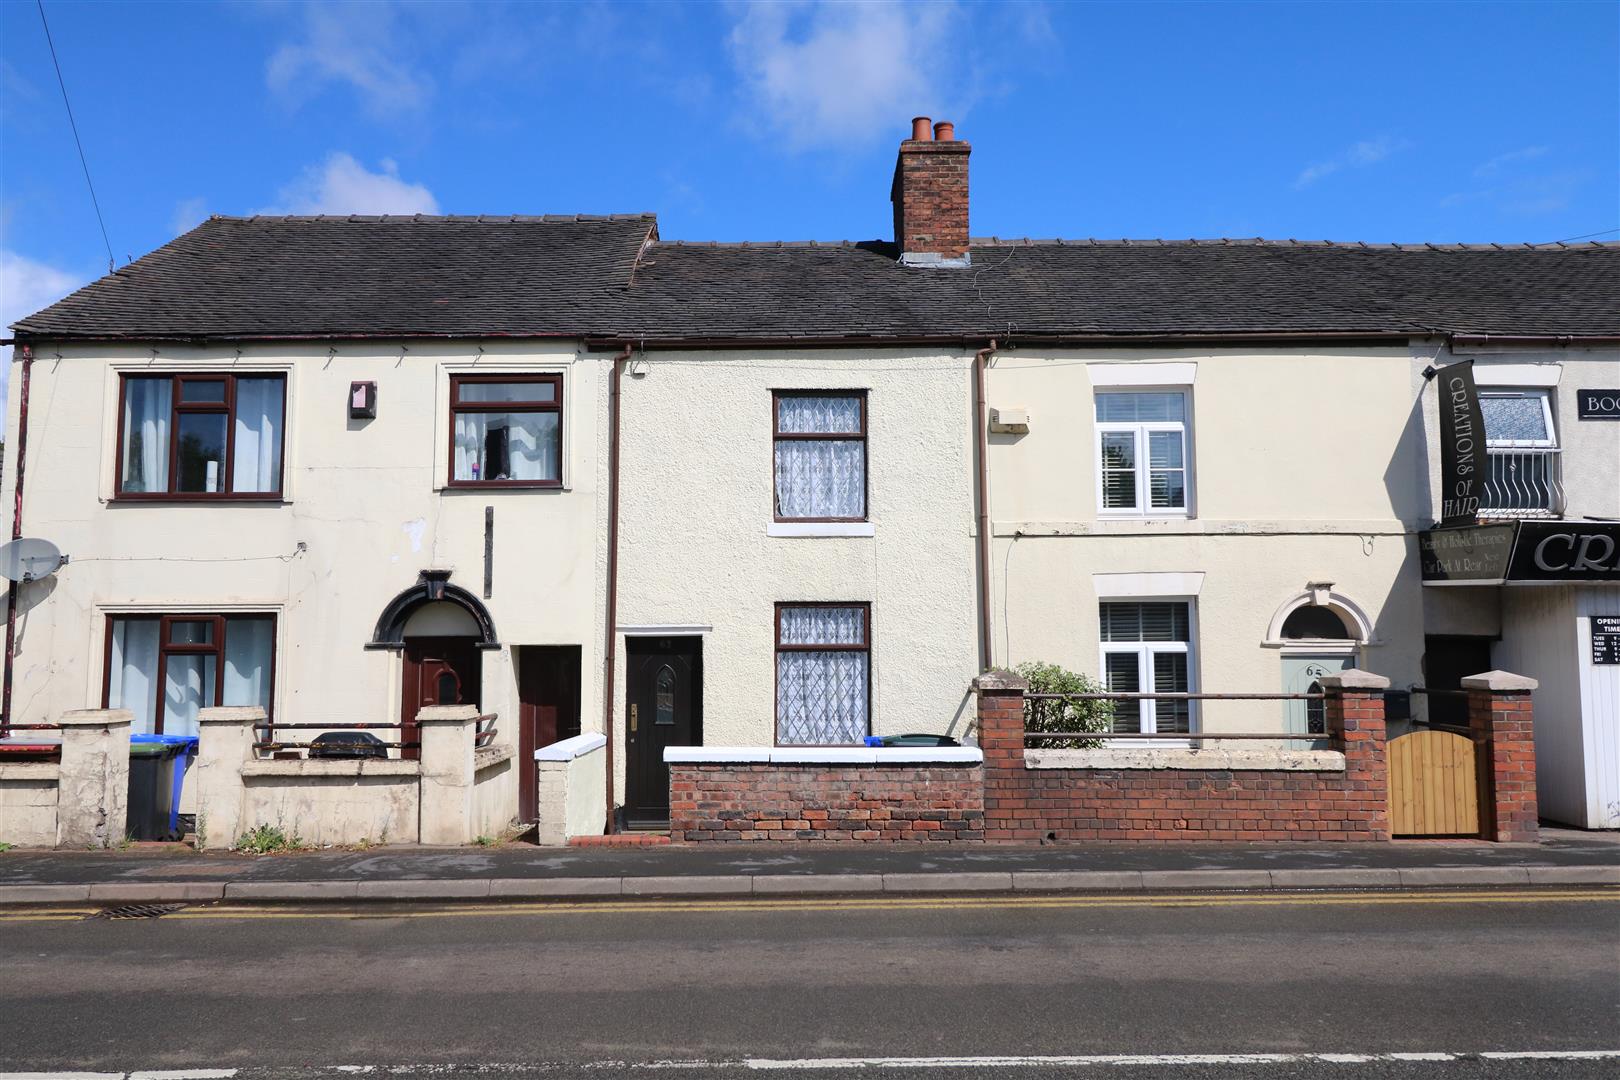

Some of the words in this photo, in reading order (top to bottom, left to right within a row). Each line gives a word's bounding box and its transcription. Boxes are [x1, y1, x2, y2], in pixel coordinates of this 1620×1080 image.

[1587, 396, 1620, 411] BO
[1449, 377, 1474, 475] CREATIONS
[1455, 479, 1473, 497] OF
[1443, 496, 1480, 518] HAIR
[1534, 533, 1620, 571] CR
[1463, 558, 1482, 572] Rear
[1306, 665, 1322, 679] 65
